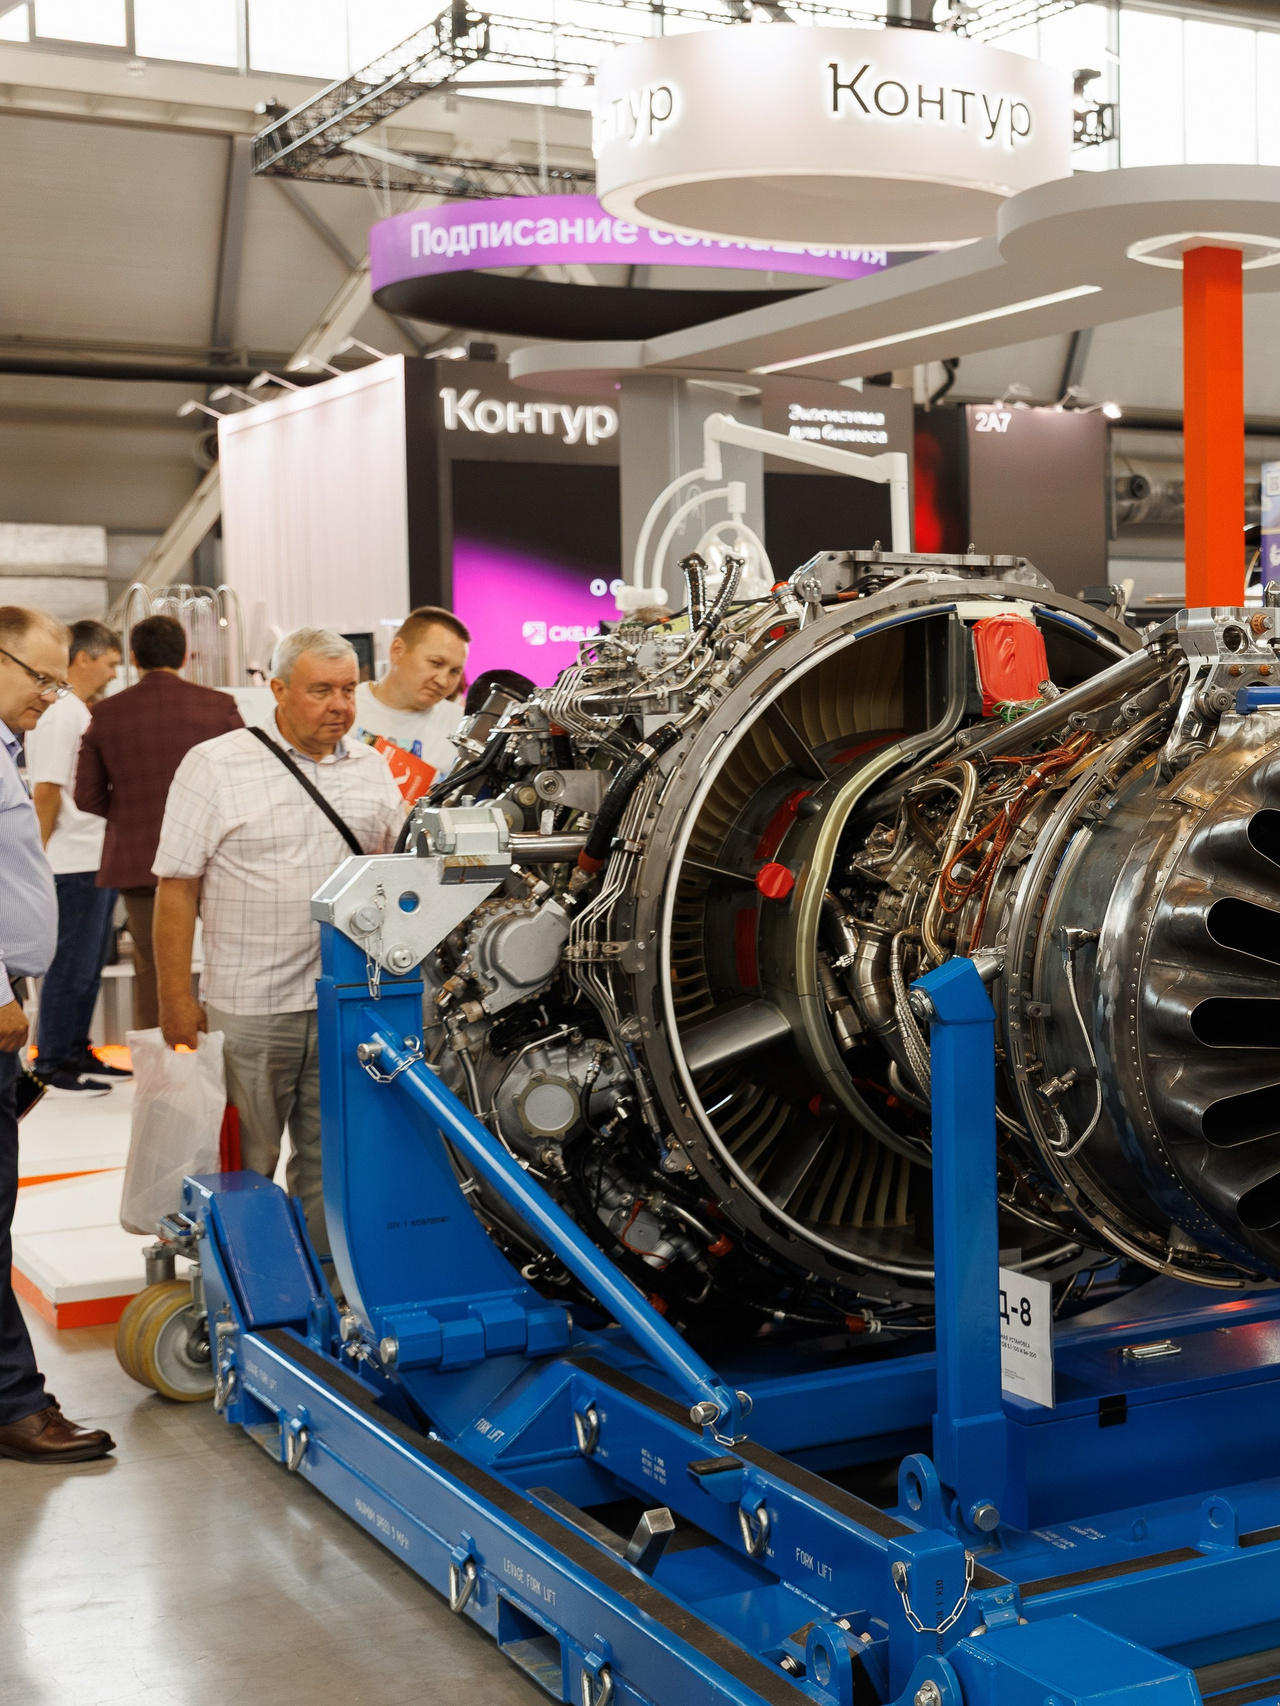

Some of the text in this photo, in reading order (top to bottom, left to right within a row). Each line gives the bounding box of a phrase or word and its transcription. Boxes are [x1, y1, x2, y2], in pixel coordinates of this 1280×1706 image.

[602, 85, 673, 141] тур
[827, 62, 1031, 146] Контур
[410, 216, 638, 258] Подписание
[439, 387, 619, 446] Контур
[474, 1417, 505, 1444] FORK LIFT
[503, 1557, 556, 1606] LEVAGE FORK LIFT
[796, 1547, 814, 1571] FORK
[817, 1560, 833, 1582] LIFT
